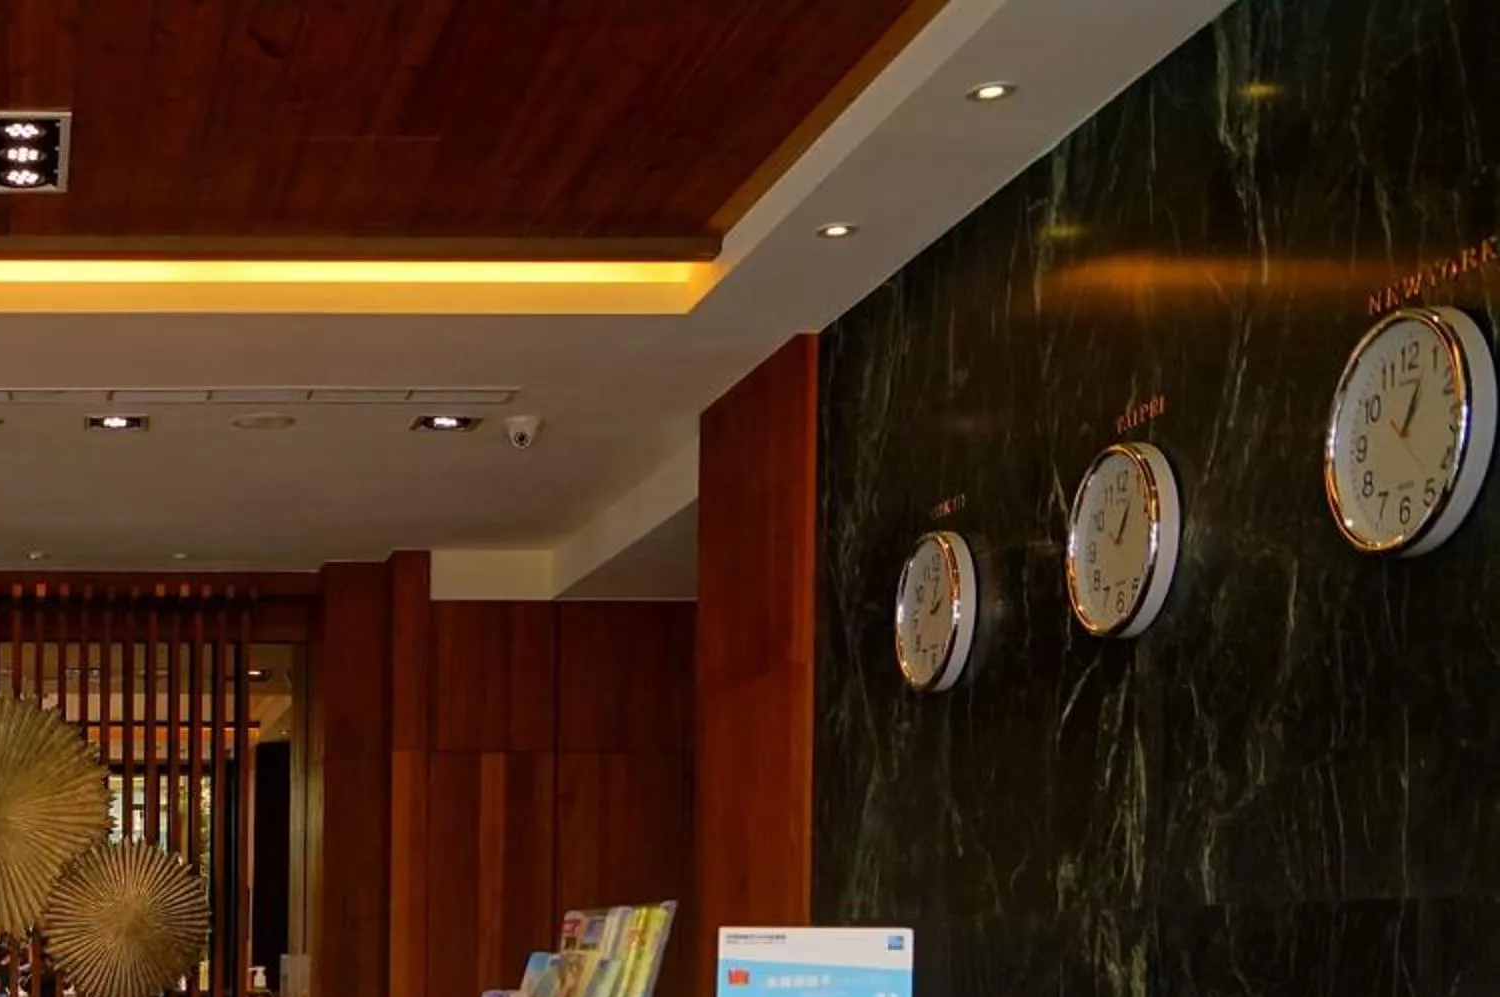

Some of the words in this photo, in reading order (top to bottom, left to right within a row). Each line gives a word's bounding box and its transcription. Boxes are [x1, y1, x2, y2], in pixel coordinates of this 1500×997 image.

[1401, 340, 1420, 373] 12
[1432, 346, 1439, 371] 1
[1381, 362, 1396, 391] 11
[1364, 394, 1382, 425] 10
[1356, 435, 1368, 463] 9
[1116, 469, 1129, 493] 12
[1362, 470, 1374, 497] 8
[1423, 478, 1436, 507] 5
[1378, 491, 1389, 521] 7
[1399, 496, 1411, 525] 6
[1102, 586, 1111, 609] 7
[1116, 591, 1125, 614] 6
